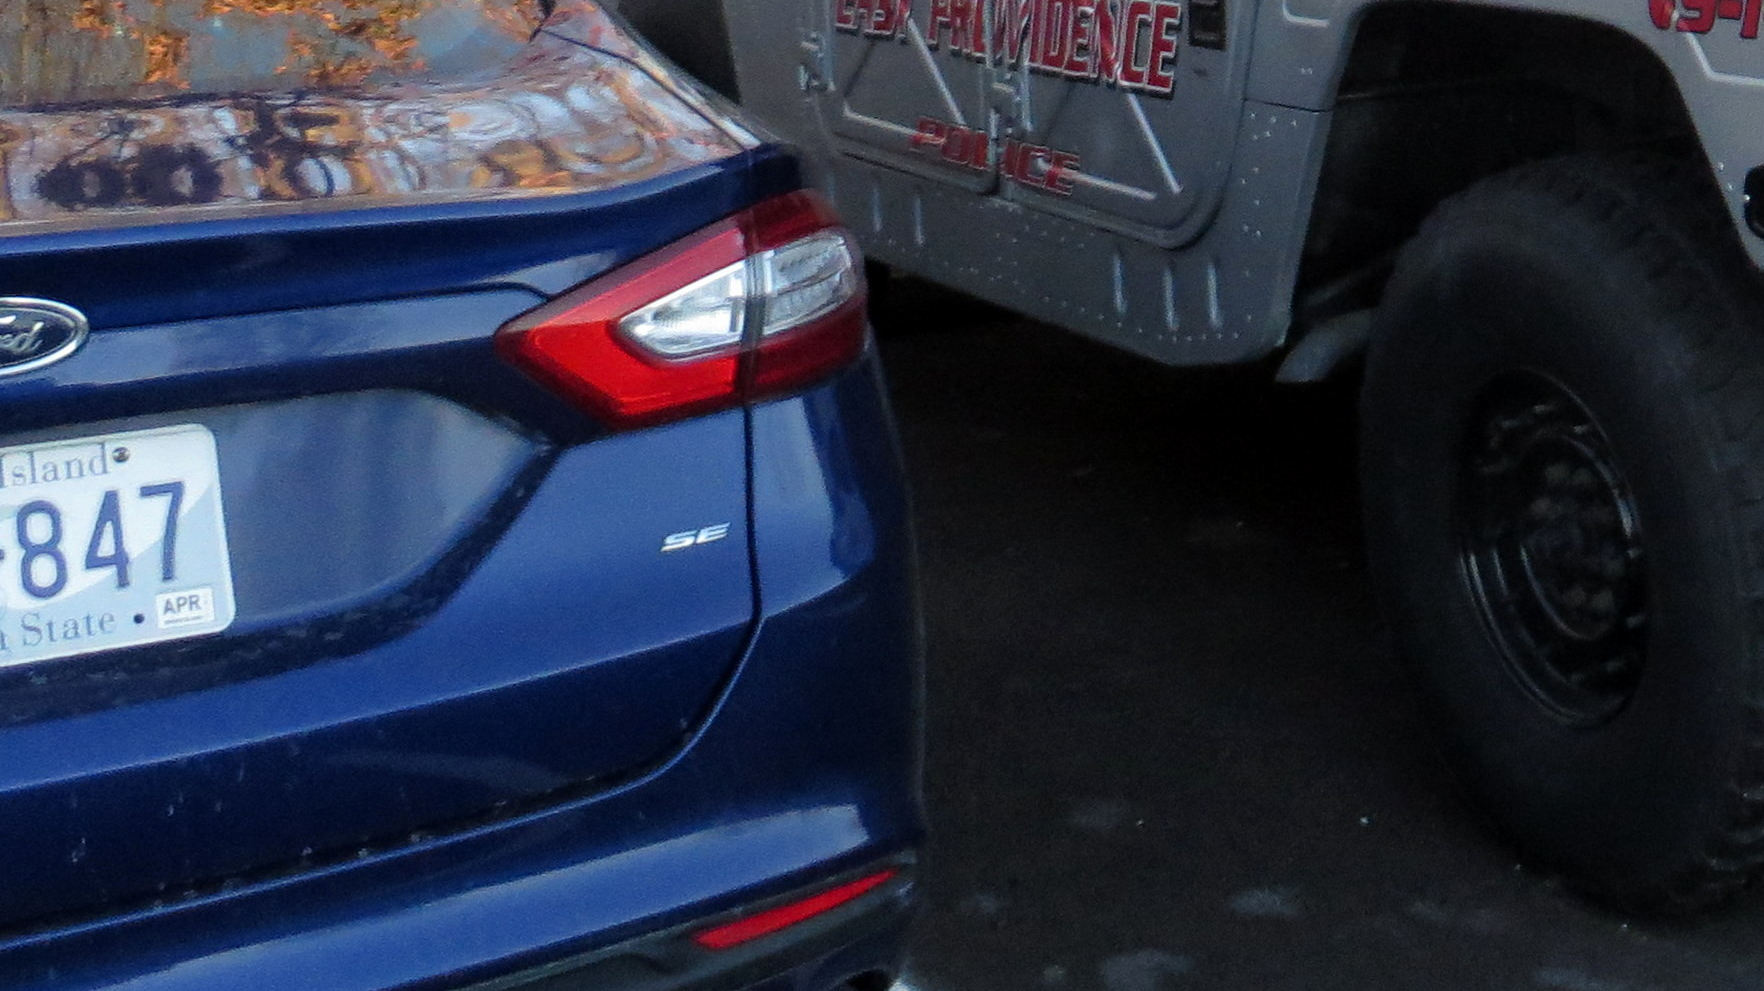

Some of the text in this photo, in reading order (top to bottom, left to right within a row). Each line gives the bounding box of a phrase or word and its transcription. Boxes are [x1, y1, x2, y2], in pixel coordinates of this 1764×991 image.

[909, 115, 1081, 196] POLICE
[660, 521, 731, 552] SE
[163, 594, 202, 616] APR
[20, 611, 118, 649] State
